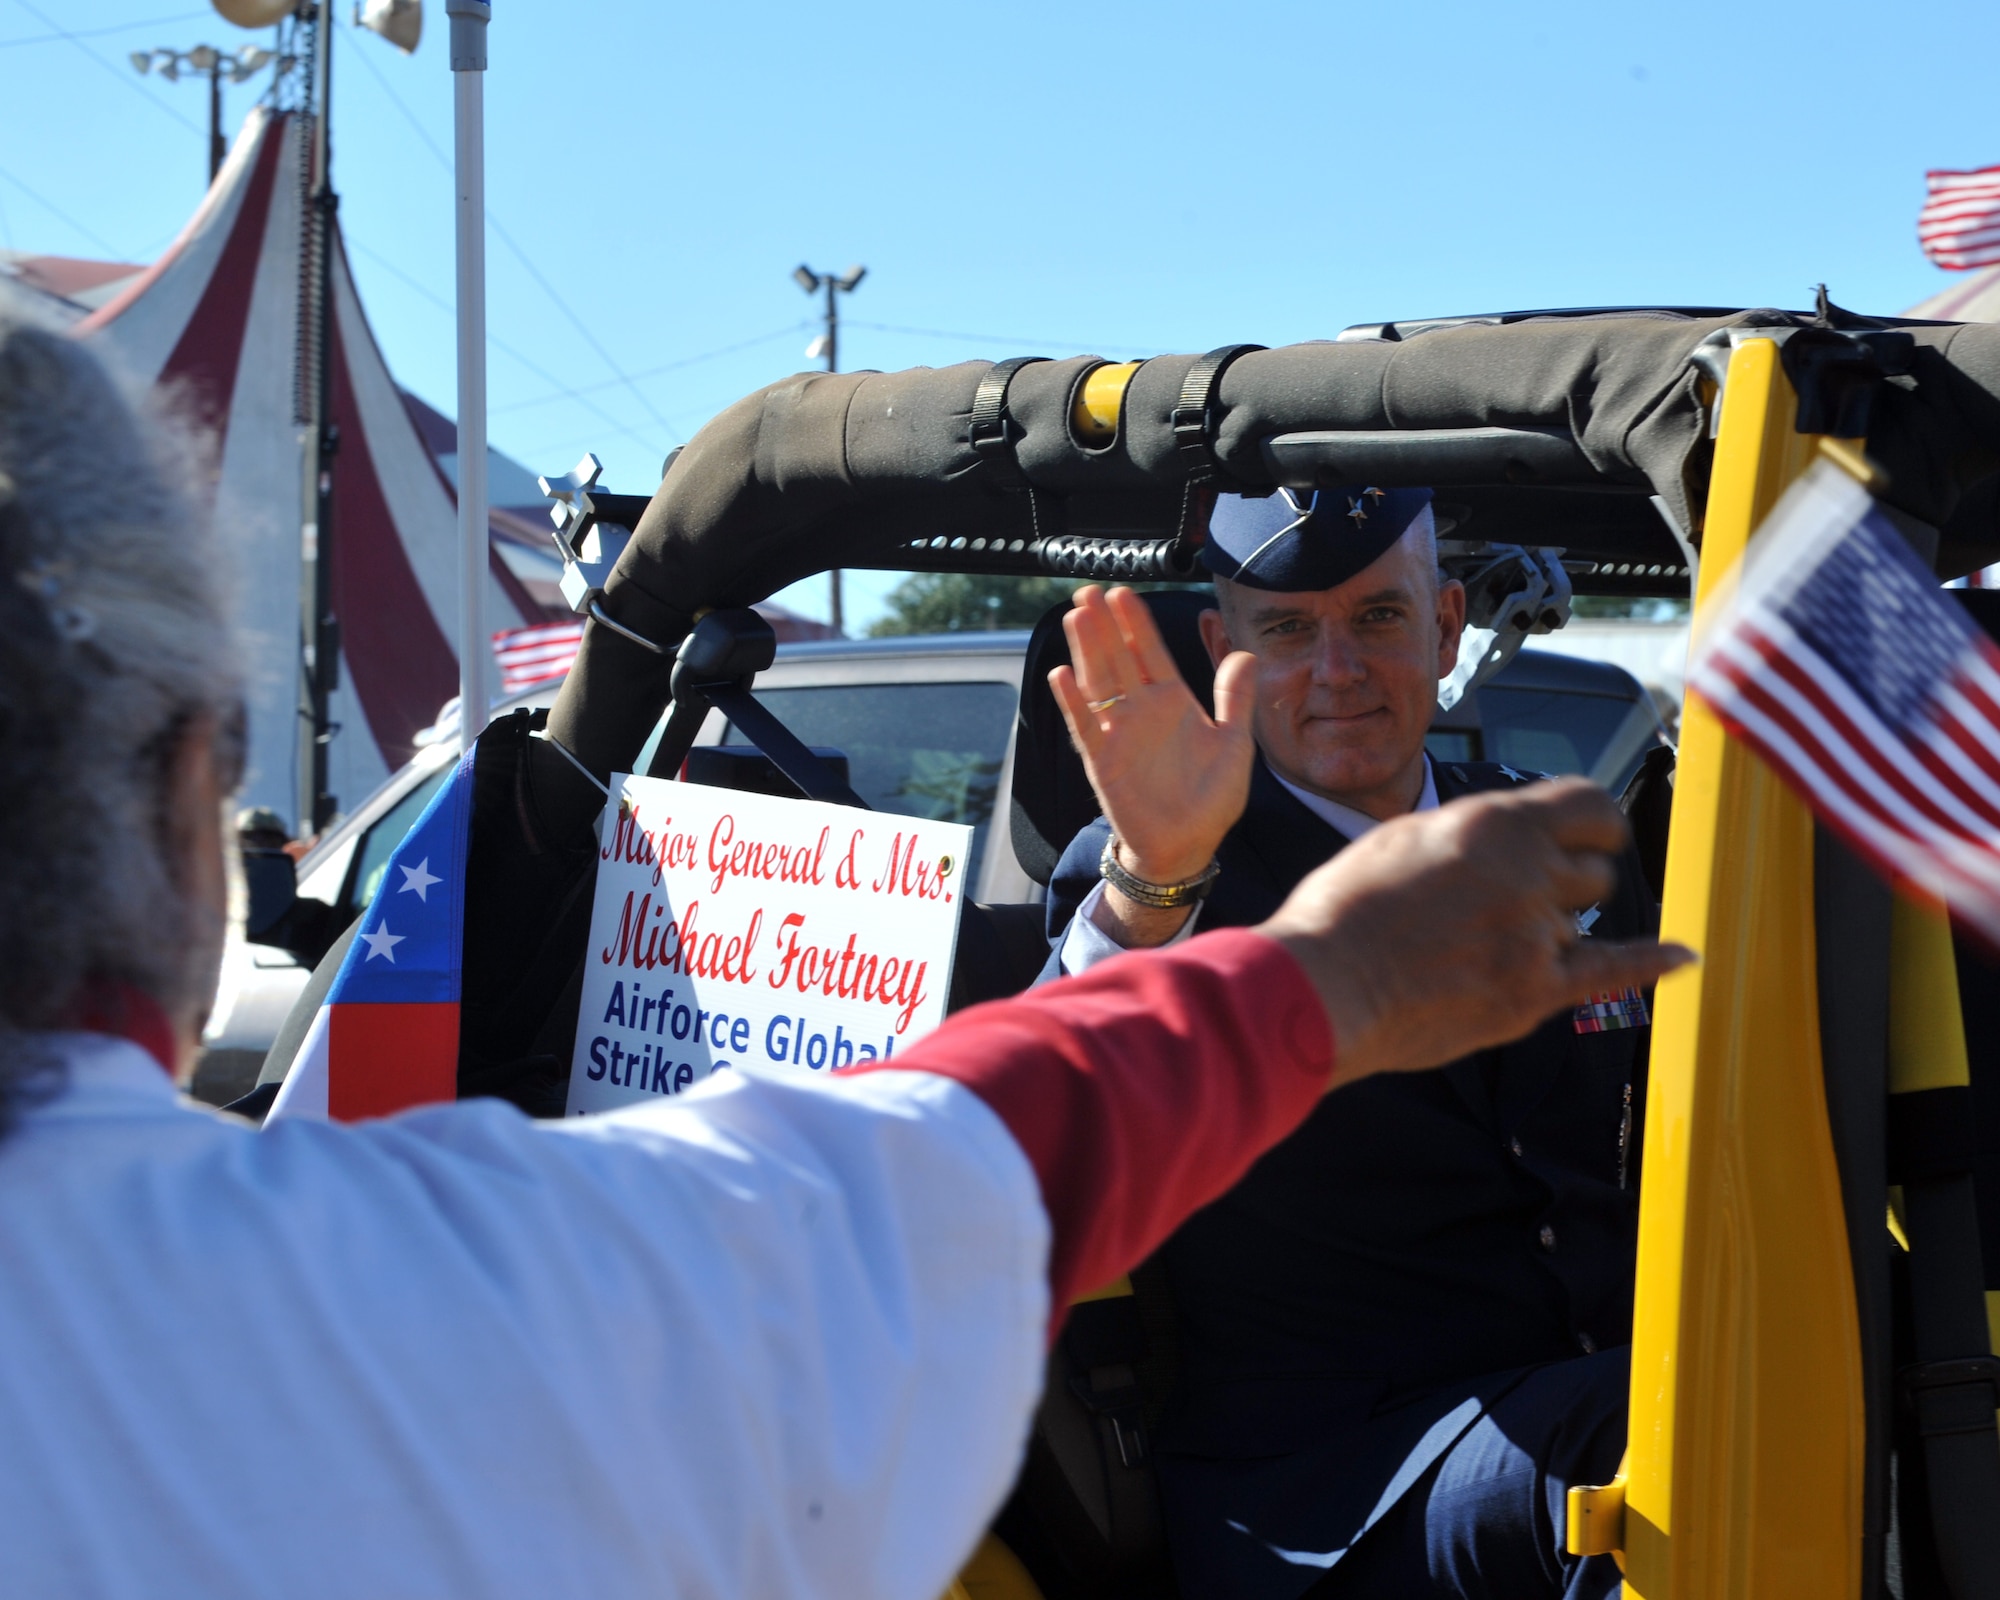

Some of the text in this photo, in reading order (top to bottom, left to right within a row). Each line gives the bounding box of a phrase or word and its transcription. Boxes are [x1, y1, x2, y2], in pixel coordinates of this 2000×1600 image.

[602, 805, 953, 903] Major General & Mrs.
[602, 891, 928, 1035] Michael Fortney
[604, 981, 750, 1053] Airforce
[587, 1036, 694, 1095] Strike
